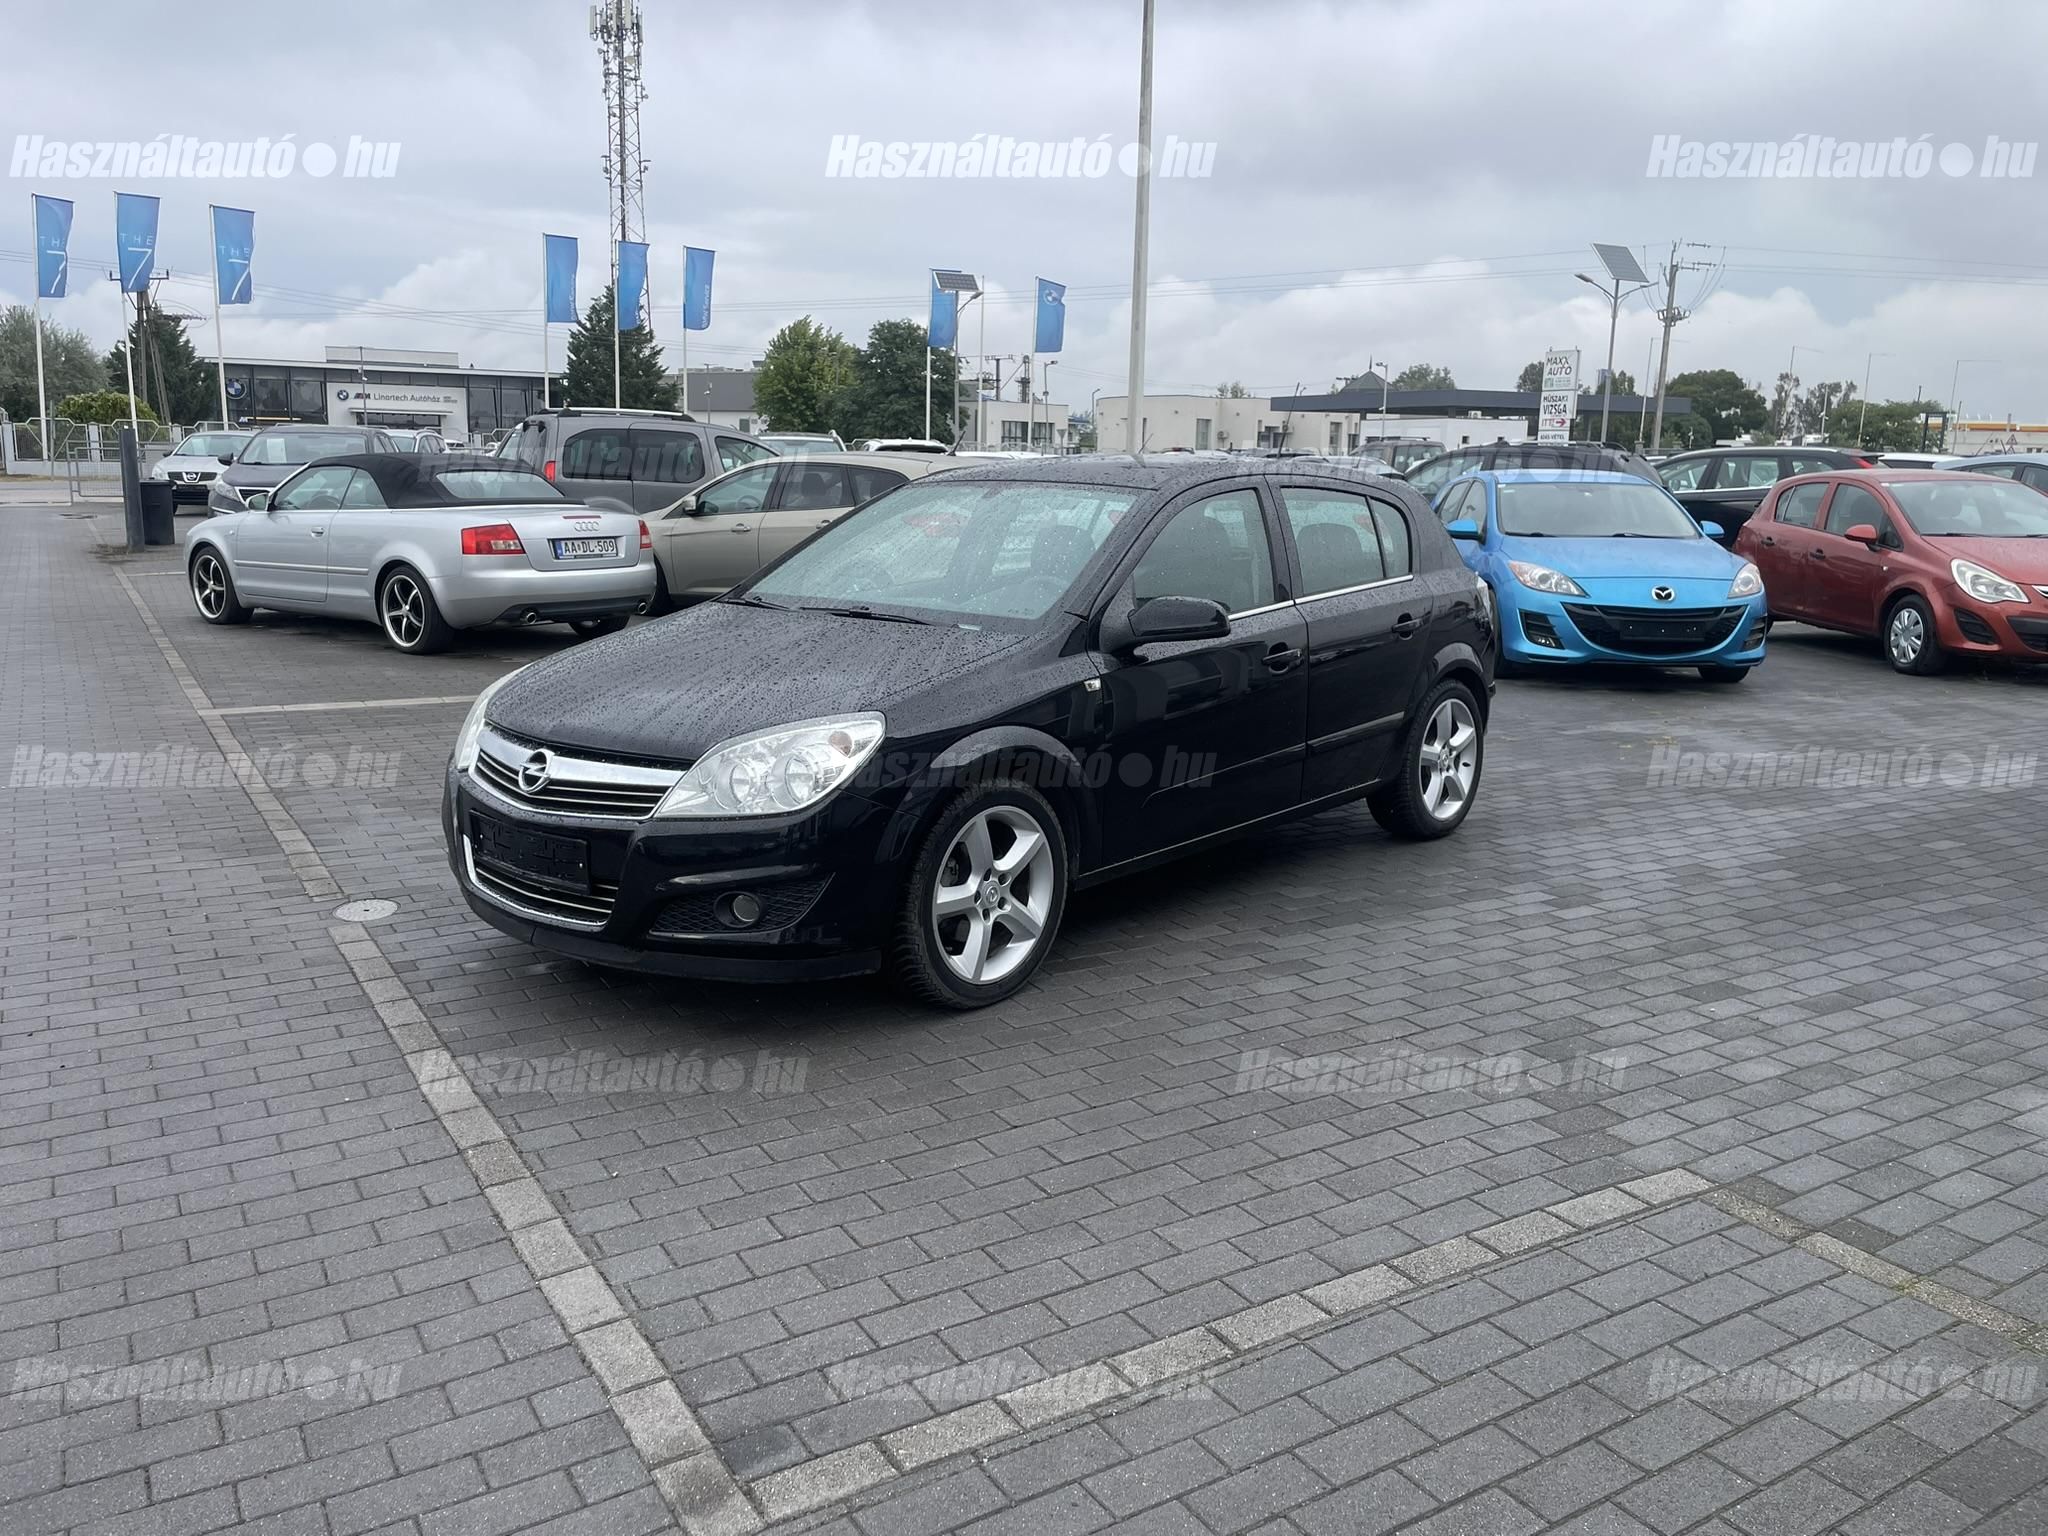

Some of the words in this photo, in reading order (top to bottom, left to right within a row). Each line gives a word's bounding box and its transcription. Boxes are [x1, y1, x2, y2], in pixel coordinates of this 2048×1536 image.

[119, 233, 153, 246] THE
[46, 250, 67, 294] 7
[128, 247, 152, 290] 7
[228, 258, 250, 301] 7
[1543, 404, 1567, 415] VIZSGA
